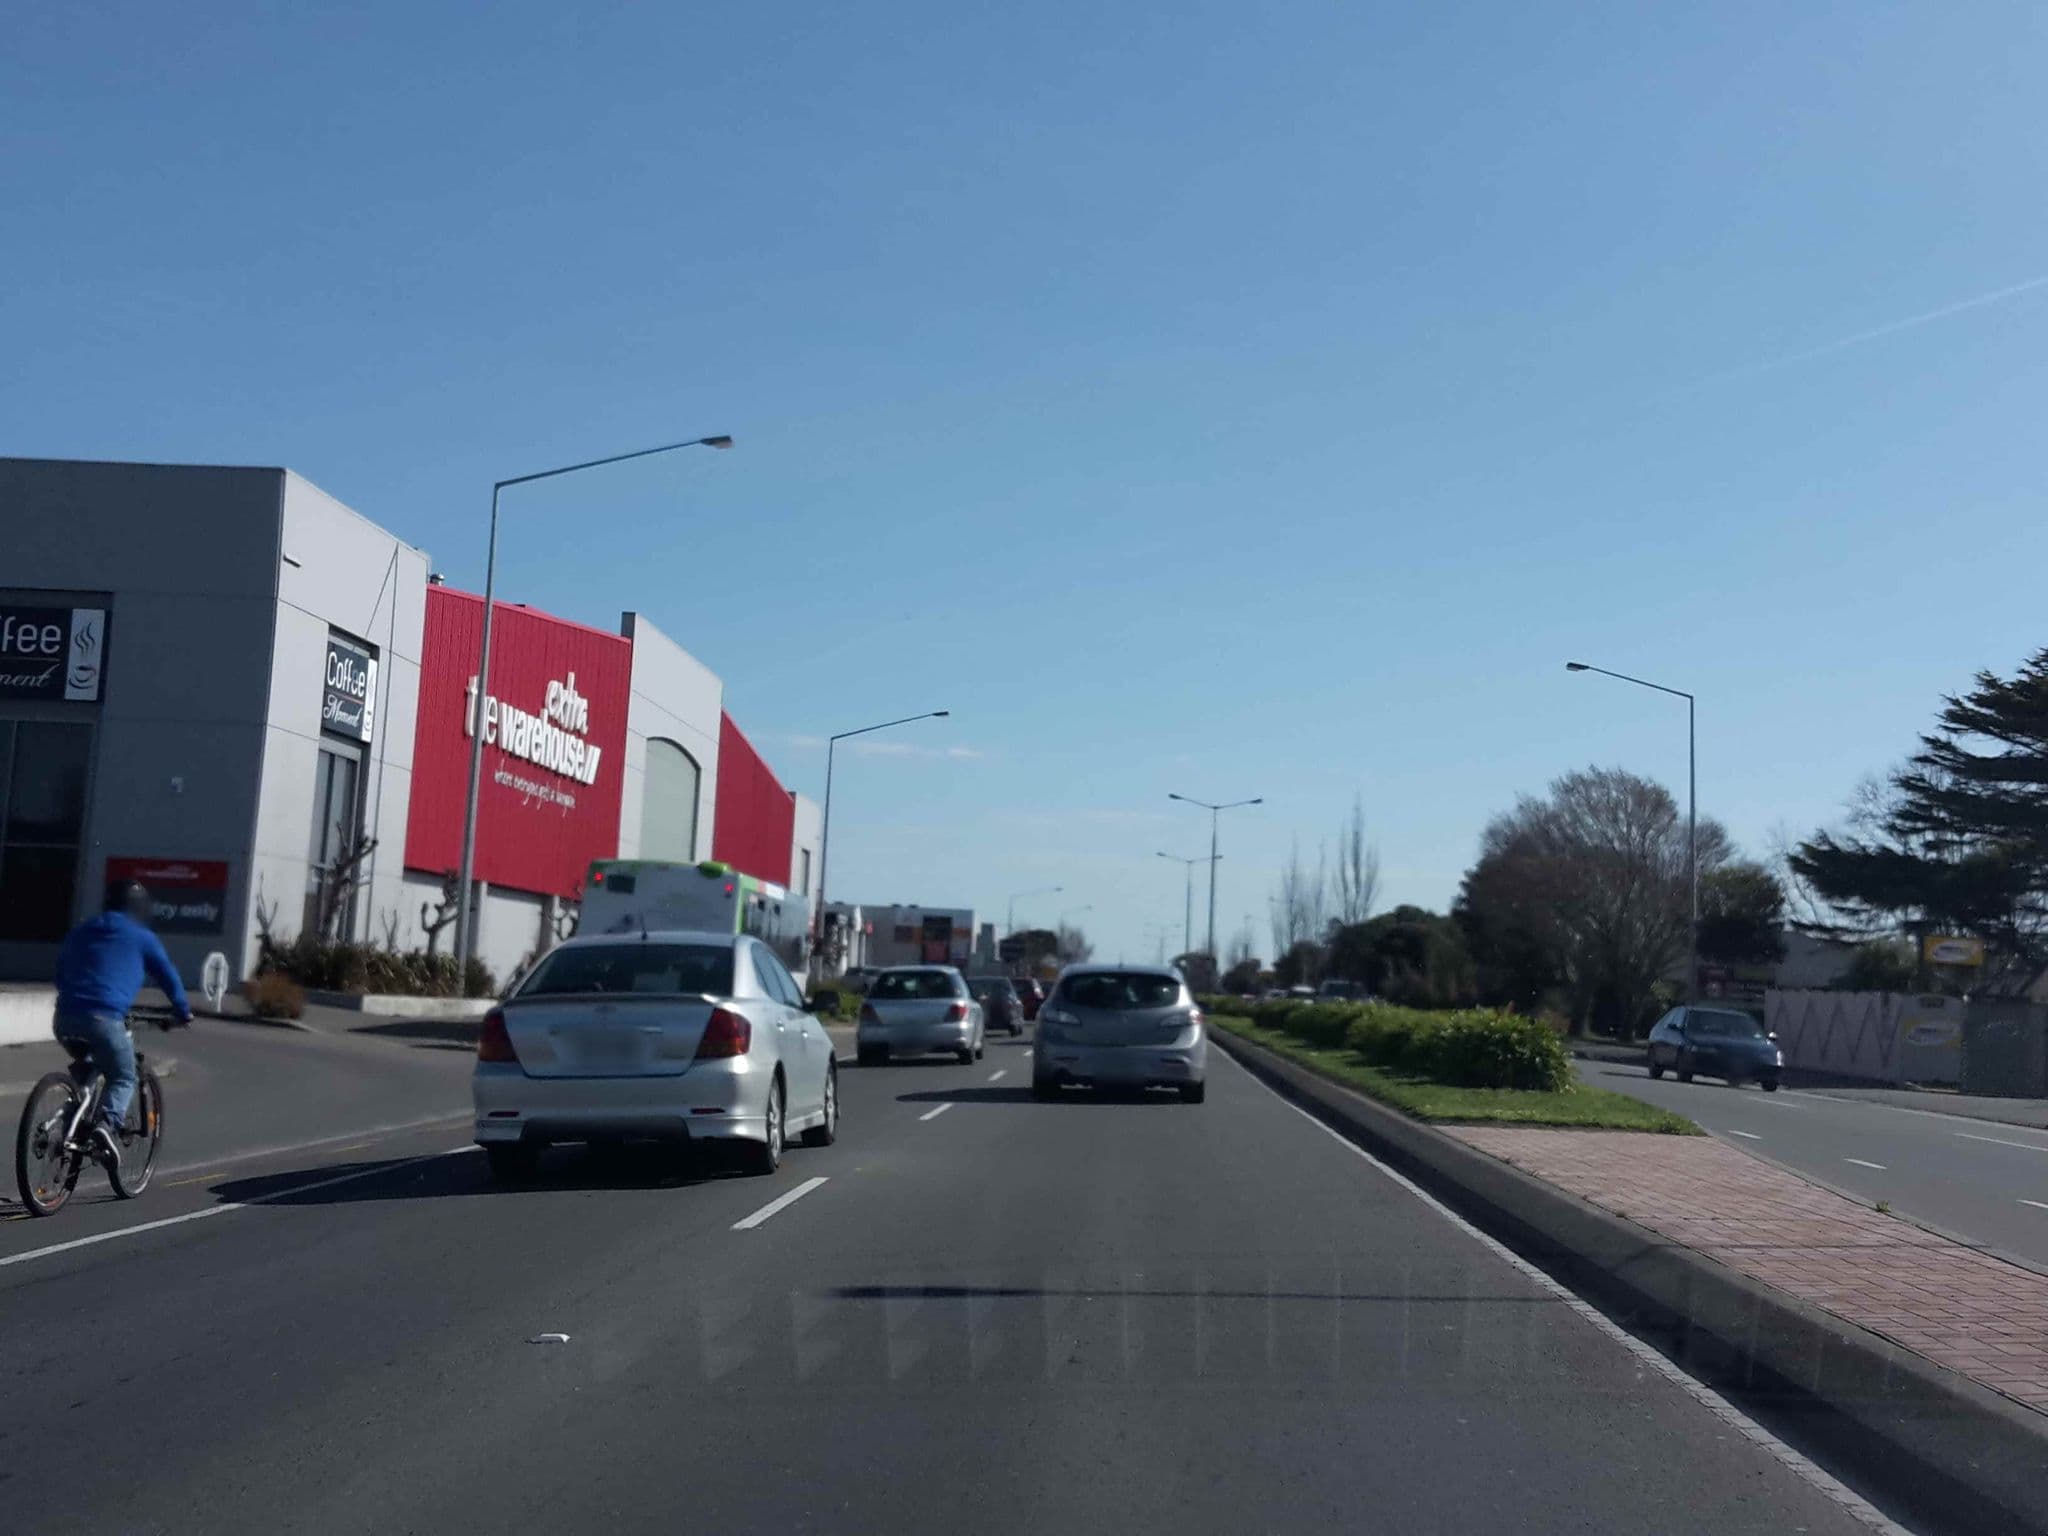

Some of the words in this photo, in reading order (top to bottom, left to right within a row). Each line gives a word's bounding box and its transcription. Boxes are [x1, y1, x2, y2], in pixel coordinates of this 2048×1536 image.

[0, 616, 61, 653] fee
[327, 652, 366, 697] Coffee
[545, 671, 589, 735] extra
[498, 701, 585, 781] warehouse
